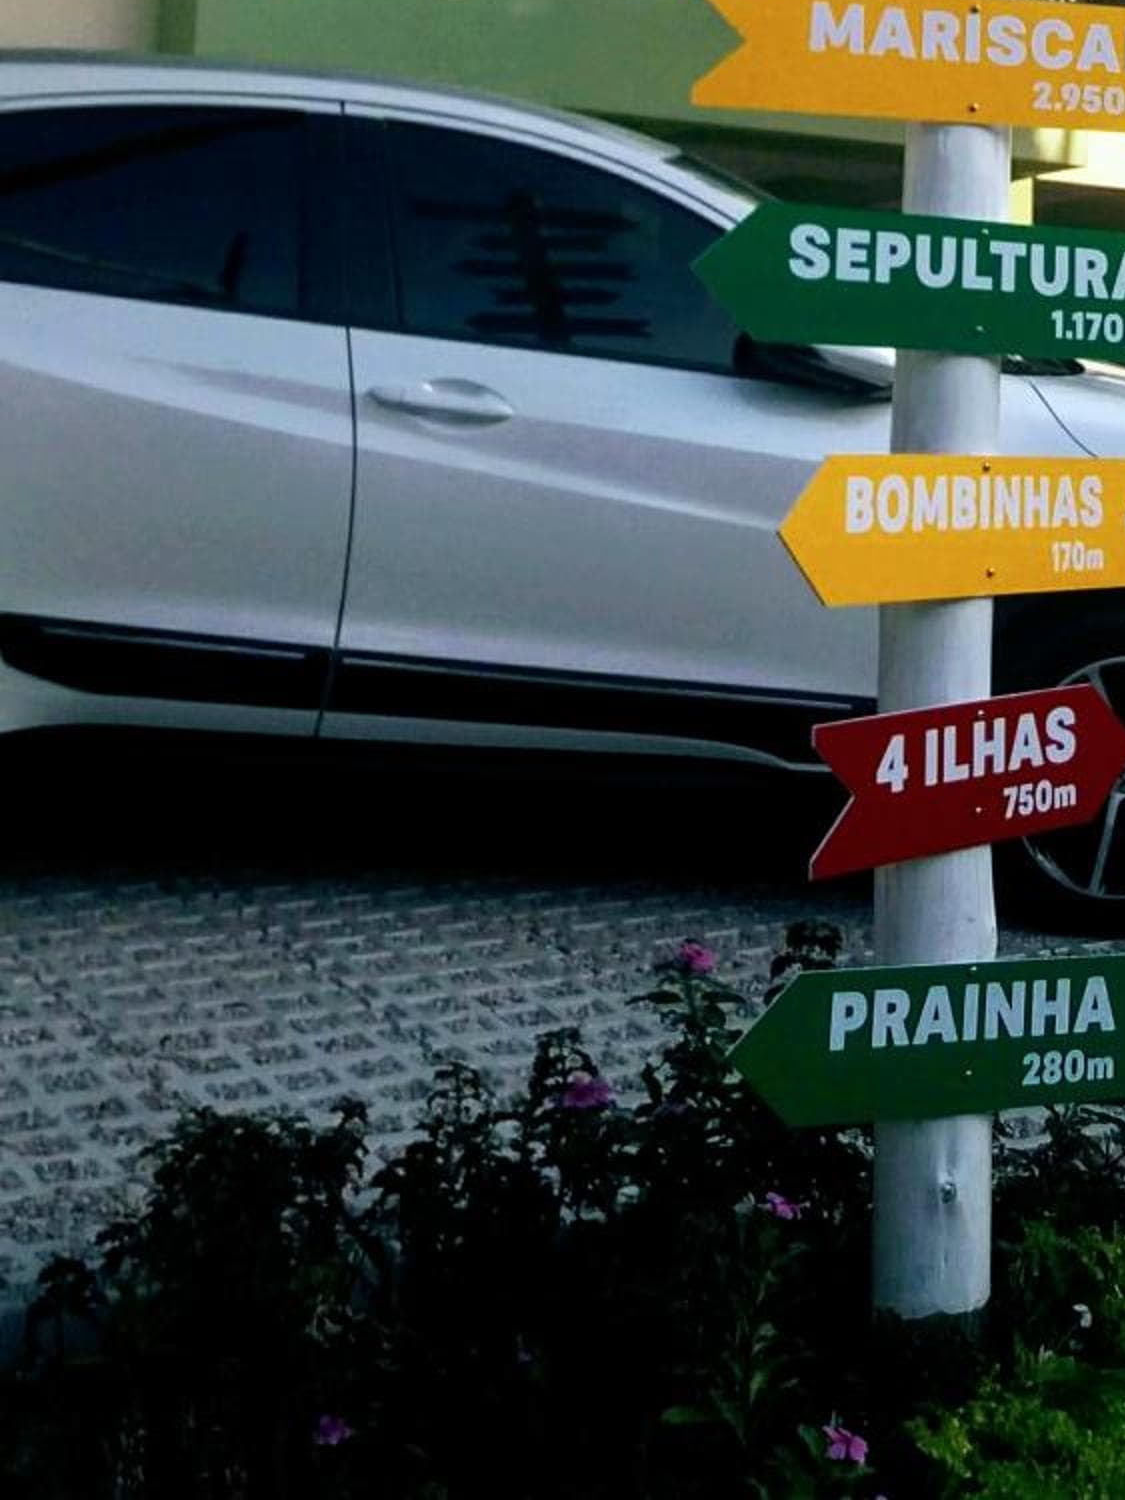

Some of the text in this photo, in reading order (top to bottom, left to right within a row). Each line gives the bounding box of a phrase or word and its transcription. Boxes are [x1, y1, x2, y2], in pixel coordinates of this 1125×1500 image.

[845, 475, 1103, 534] BOMBINHAS
[1051, 542, 1104, 572] 170m
[876, 706, 1077, 793] 4 ILHAS
[1003, 780, 1077, 820] 750m
[829, 976, 1116, 1052] PRAINHA
[1022, 1049, 1115, 1088] 280m
